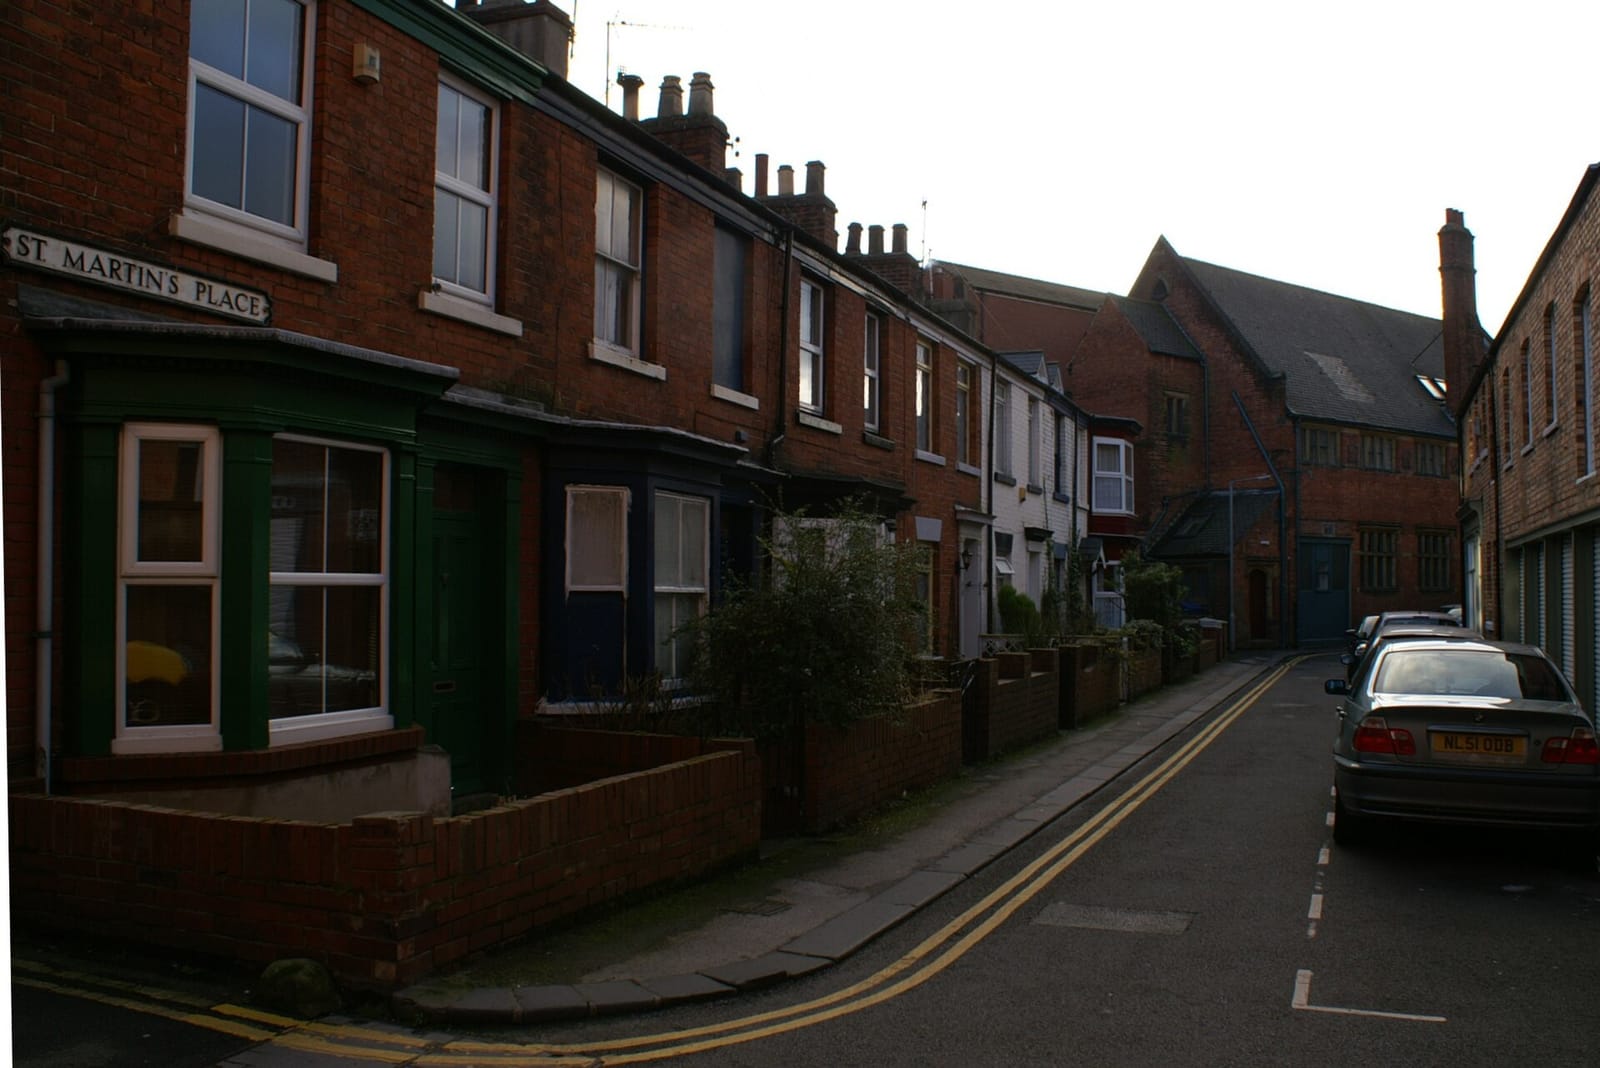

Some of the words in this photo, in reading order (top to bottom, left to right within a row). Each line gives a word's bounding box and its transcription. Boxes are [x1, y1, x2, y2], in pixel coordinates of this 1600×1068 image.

[62, 247, 179, 294] MARTIN'S
[195, 281, 260, 316] PLACE
[1444, 735, 1479, 750] NL51
